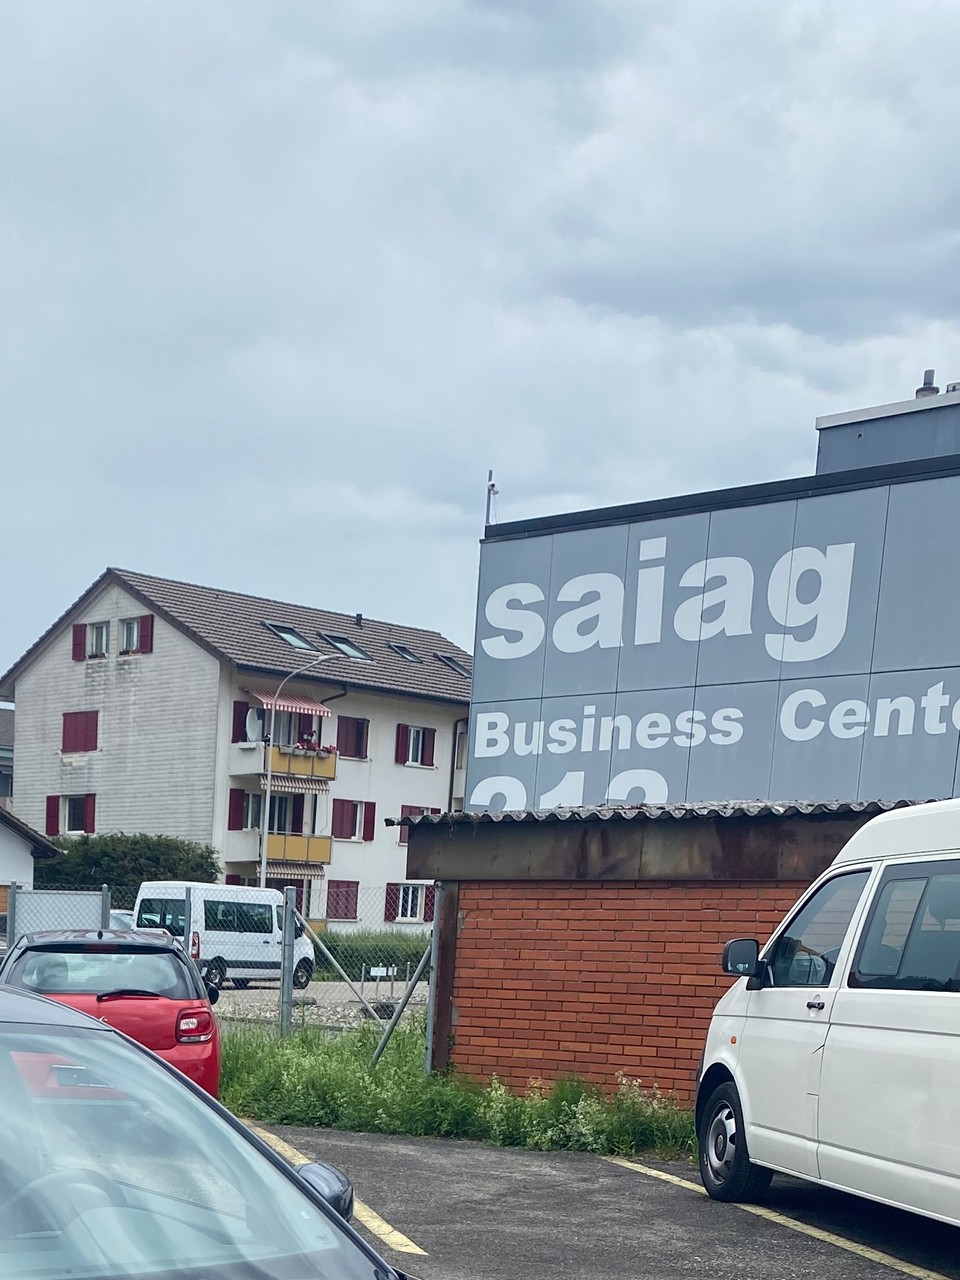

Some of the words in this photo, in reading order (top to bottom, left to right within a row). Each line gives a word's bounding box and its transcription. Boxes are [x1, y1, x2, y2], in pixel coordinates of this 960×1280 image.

[481, 537, 855, 663] saiag
[474, 705, 744, 758] Business
[779, 681, 960, 741] Cent
